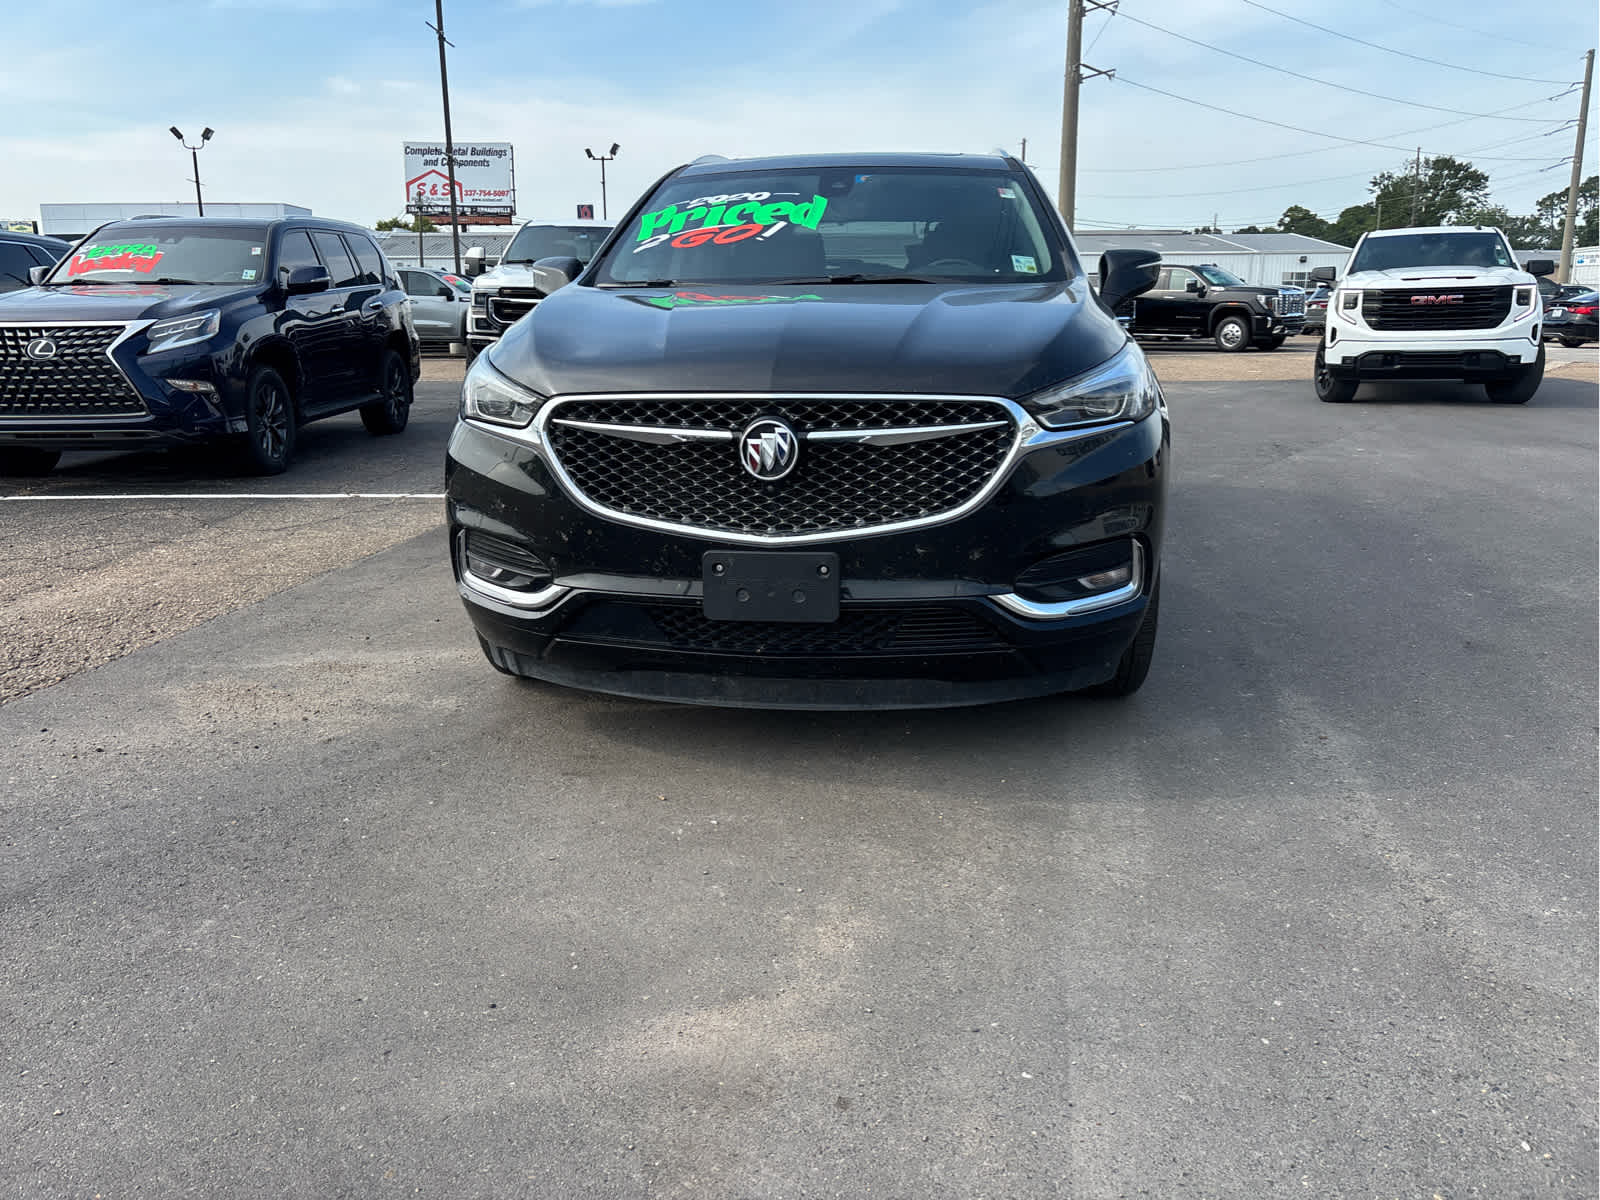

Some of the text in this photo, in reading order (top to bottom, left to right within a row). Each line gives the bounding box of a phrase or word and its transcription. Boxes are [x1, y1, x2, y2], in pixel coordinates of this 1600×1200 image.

[404, 146, 442, 157] Complete
[470, 147, 507, 158] Buildings
[423, 158, 490, 168] and Cponents
[416, 182, 426, 197] S
[429, 183, 438, 196] &
[687, 191, 772, 208] 2020
[636, 194, 828, 241] Priced
[87, 243, 157, 258] EXTRA
[1411, 295, 1464, 304] GMC
